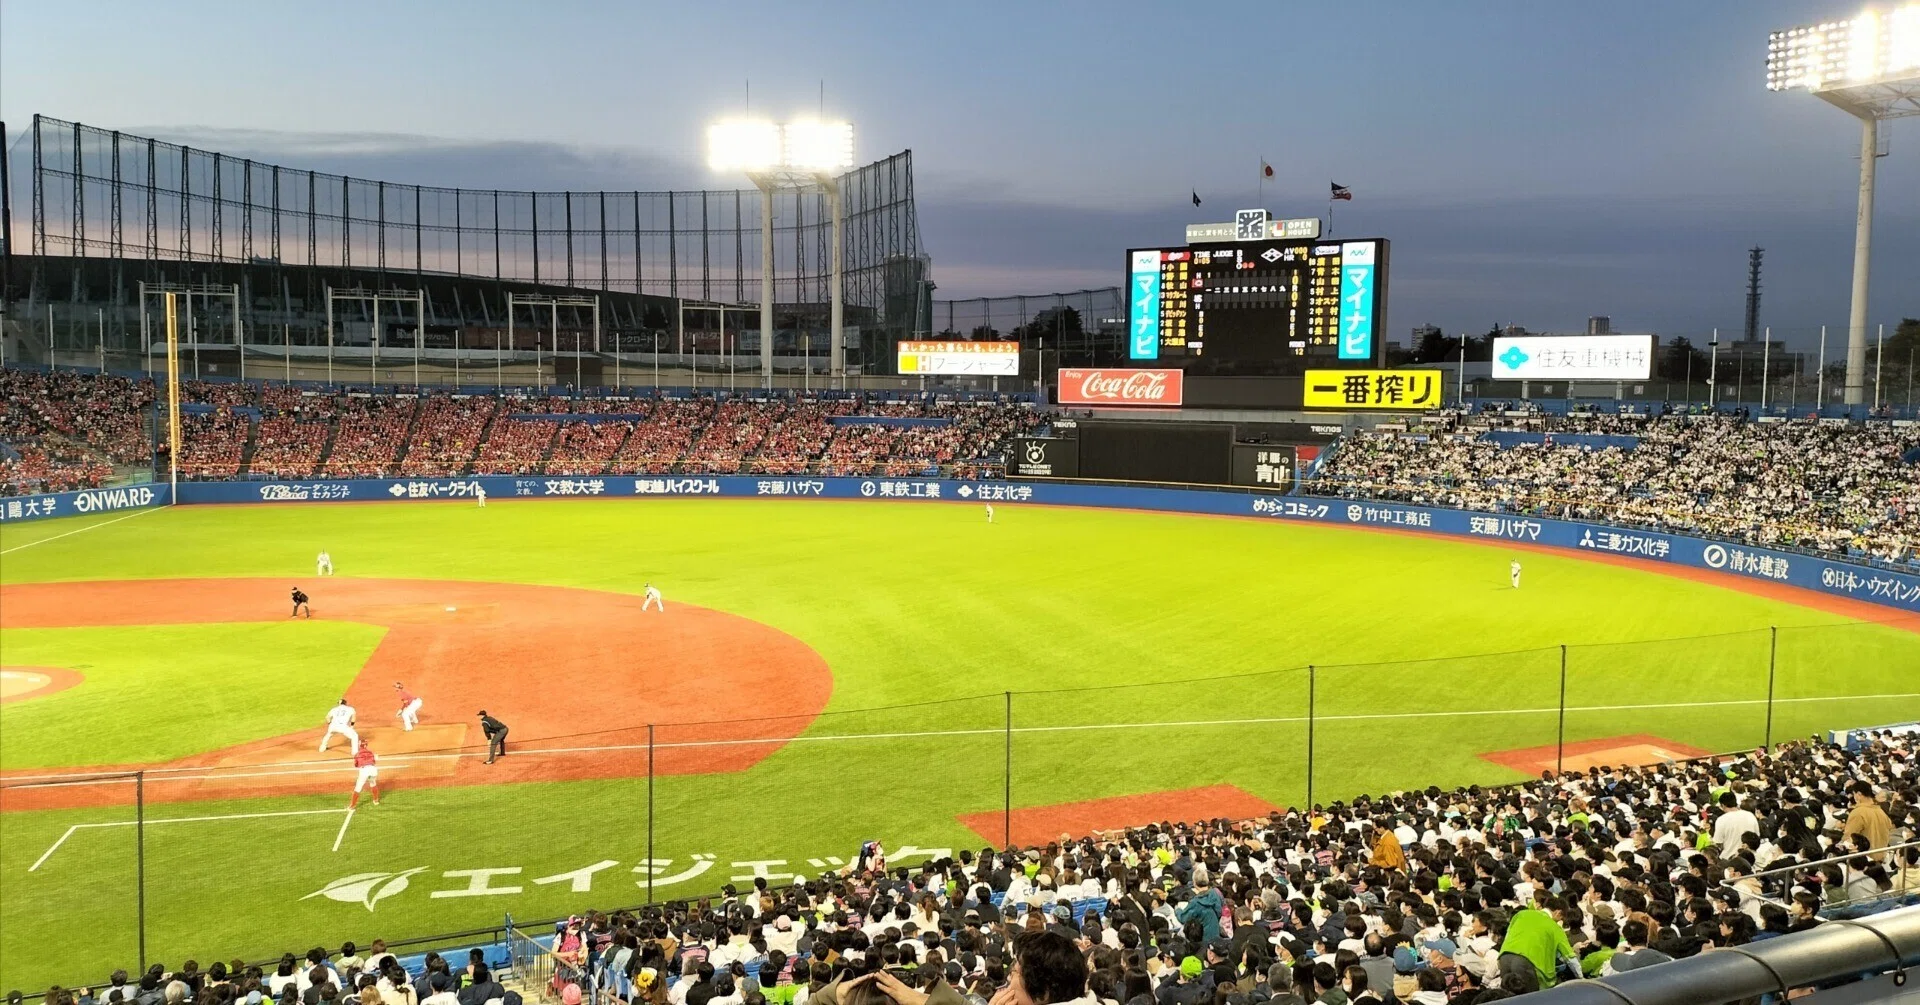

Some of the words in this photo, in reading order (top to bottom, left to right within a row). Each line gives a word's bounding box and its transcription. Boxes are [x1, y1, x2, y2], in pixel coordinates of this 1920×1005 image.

[1288, 221, 1312, 230] OPEN
[1316, 297, 1339, 306] オスナ
[1345, 268, 1368, 354] マイナビ
[1136, 275, 1155, 355] マイナビ
[1537, 348, 1645, 368] 住友重機械
[1065, 371, 1082, 379] Enjoy
[1313, 375, 1431, 404] 一番搾り
[1258, 452, 1289, 464] 洋服の
[1256, 464, 1290, 483] 青山
[544, 480, 605, 495] 文教大学
[635, 479, 720, 494] 東進ハイスクール
[757, 481, 824, 495] 安藤ハザマ
[879, 481, 941, 498] 東鉄工業
[976, 485, 1033, 500] 住友化学
[74, 487, 155, 512] ONWARD
[1253, 497, 1329, 518] めちゃコミック
[1365, 506, 1432, 527] 竹中工務店
[1470, 515, 1541, 541] 安藤ハザマ
[1597, 531, 1669, 557] 三菱ガス化学
[1730, 549, 1788, 580] 清水建設
